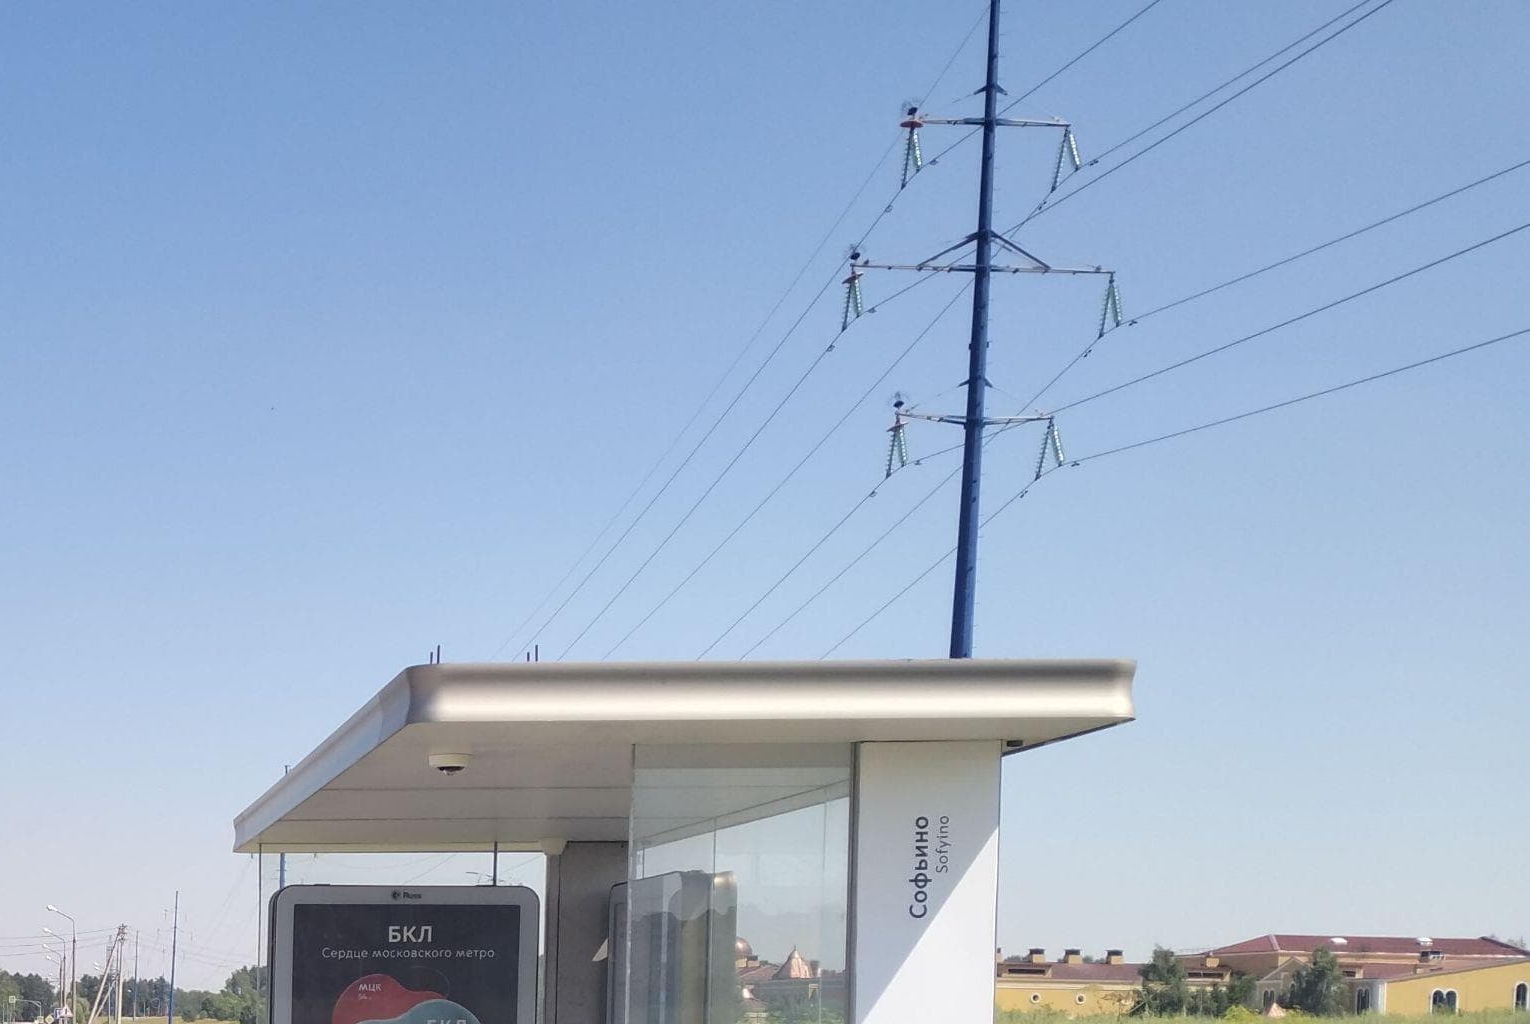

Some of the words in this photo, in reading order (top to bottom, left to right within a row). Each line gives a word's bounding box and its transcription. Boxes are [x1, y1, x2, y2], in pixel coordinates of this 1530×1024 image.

[936, 815, 951, 873] Sofyino
[909, 816, 932, 918] Софьино
[388, 925, 432, 943] БКЛ
[321, 947, 368, 960] Сердце
[372, 949, 452, 960] московского
[455, 949, 495, 960] метро
